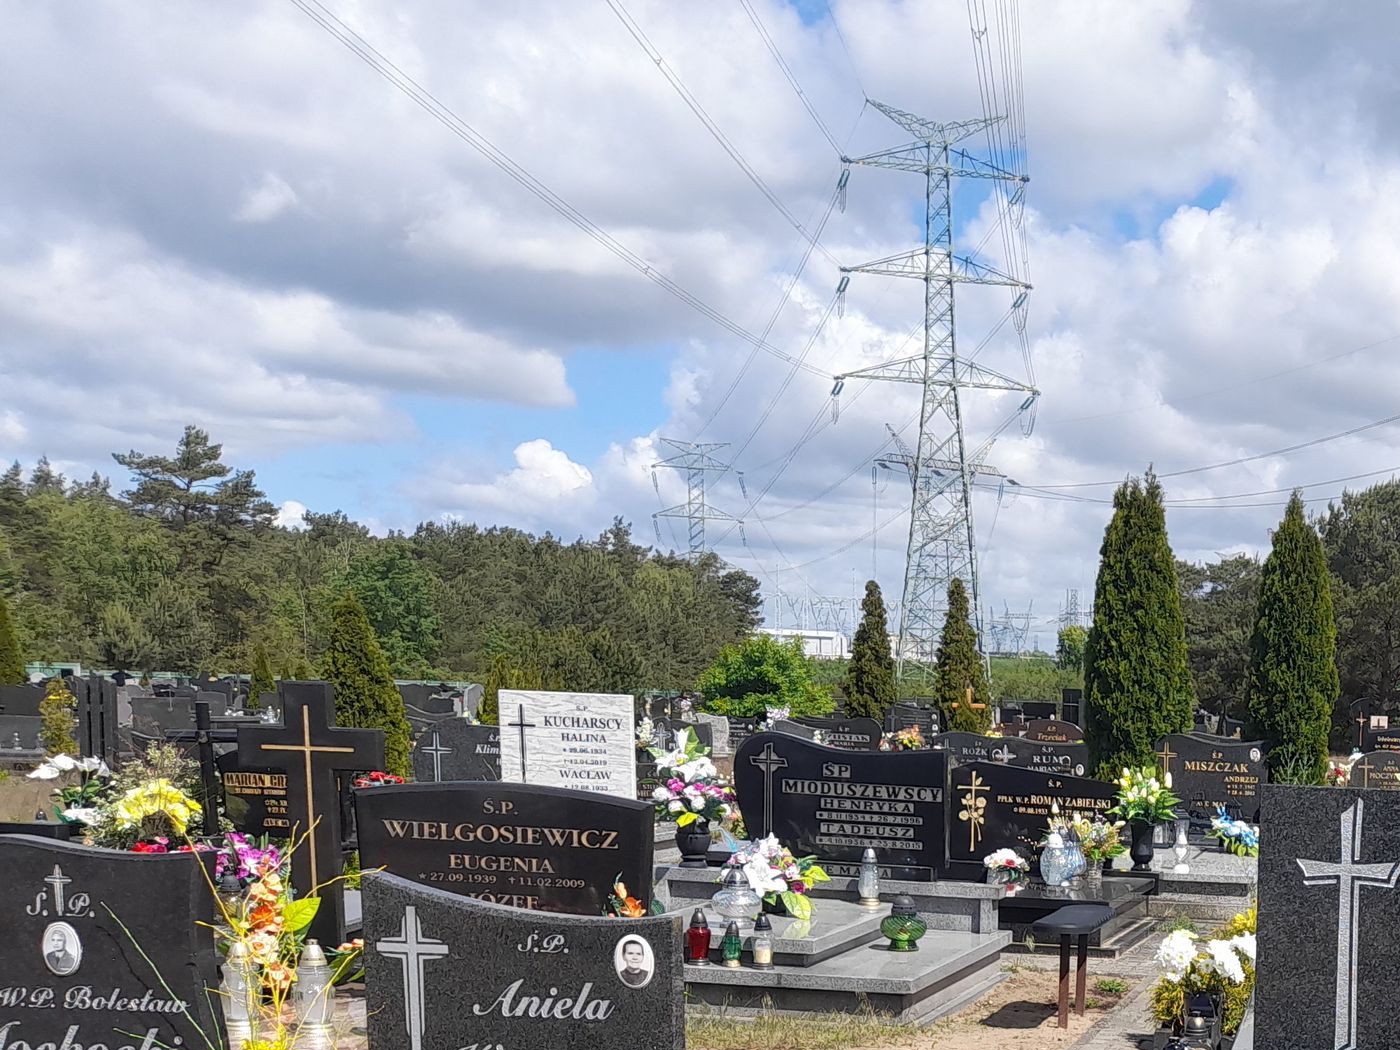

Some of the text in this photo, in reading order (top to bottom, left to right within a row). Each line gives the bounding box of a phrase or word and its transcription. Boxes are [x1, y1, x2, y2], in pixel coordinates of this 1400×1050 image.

[544, 716, 623, 730] KUCHARSCY
[561, 732, 607, 743] HALINA
[1184, 761, 1249, 773] MISZCZAK
[224, 773, 265, 787] MARIAN
[1224, 776, 1258, 784] ANDRZEJ
[784, 780, 941, 801] MIODUSZEWSCY
[483, 799, 518, 816] Ś.P.
[823, 799, 912, 813] HENRYKA
[1031, 795, 1064, 806] ROMAN
[383, 819, 619, 849] WIELGOSIEWICZ
[823, 824, 912, 837] TADEUSZ
[449, 854, 555, 874] EUGENIA
[430, 872, 585, 888] 27.09.1939 11.02.2009
[517, 930, 569, 954] Ś.P.
[64, 985, 191, 1013] Bolesław
[473, 979, 616, 1020] Aniela
